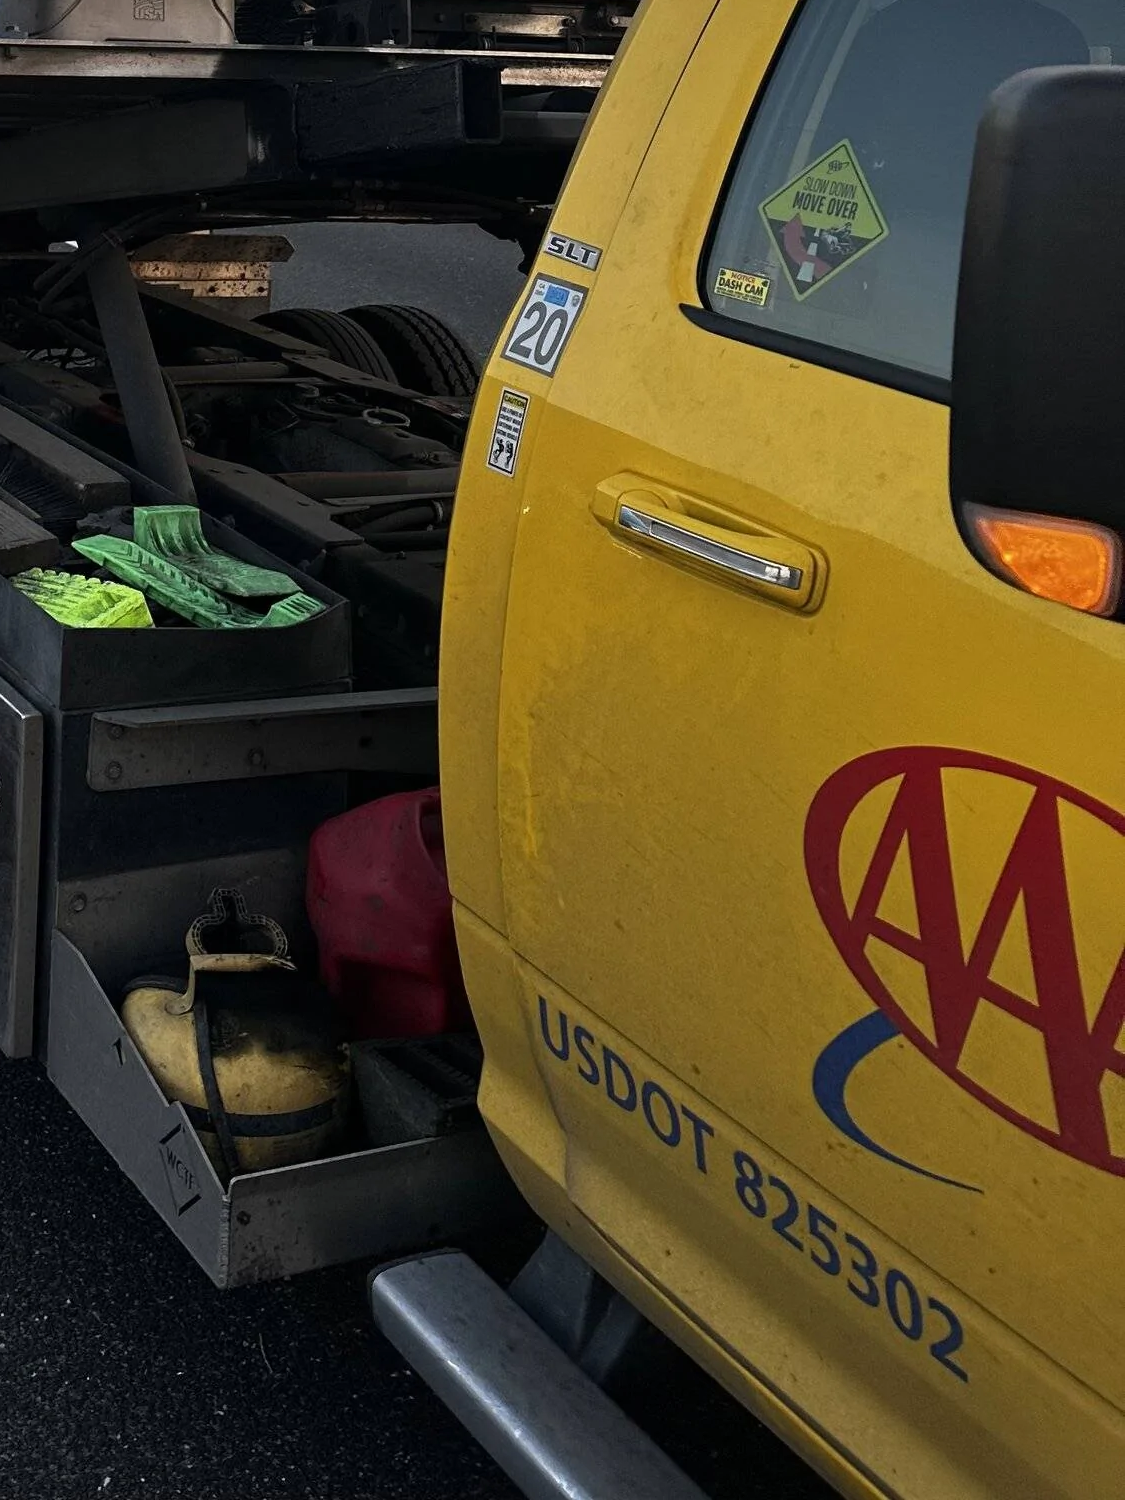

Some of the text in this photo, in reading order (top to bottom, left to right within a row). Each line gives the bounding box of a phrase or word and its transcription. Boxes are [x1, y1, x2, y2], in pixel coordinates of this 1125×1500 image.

[803, 176, 857, 200] SLOW DOWN
[792, 190, 858, 220] MOVE OVER
[548, 236, 596, 264] SLT
[718, 277, 743, 291] DASH
[744, 283, 764, 297] CAM
[731, 272, 756, 284] NOTICE
[509, 301, 569, 365] 20
[538, 995, 968, 1383] USDOT 825302
